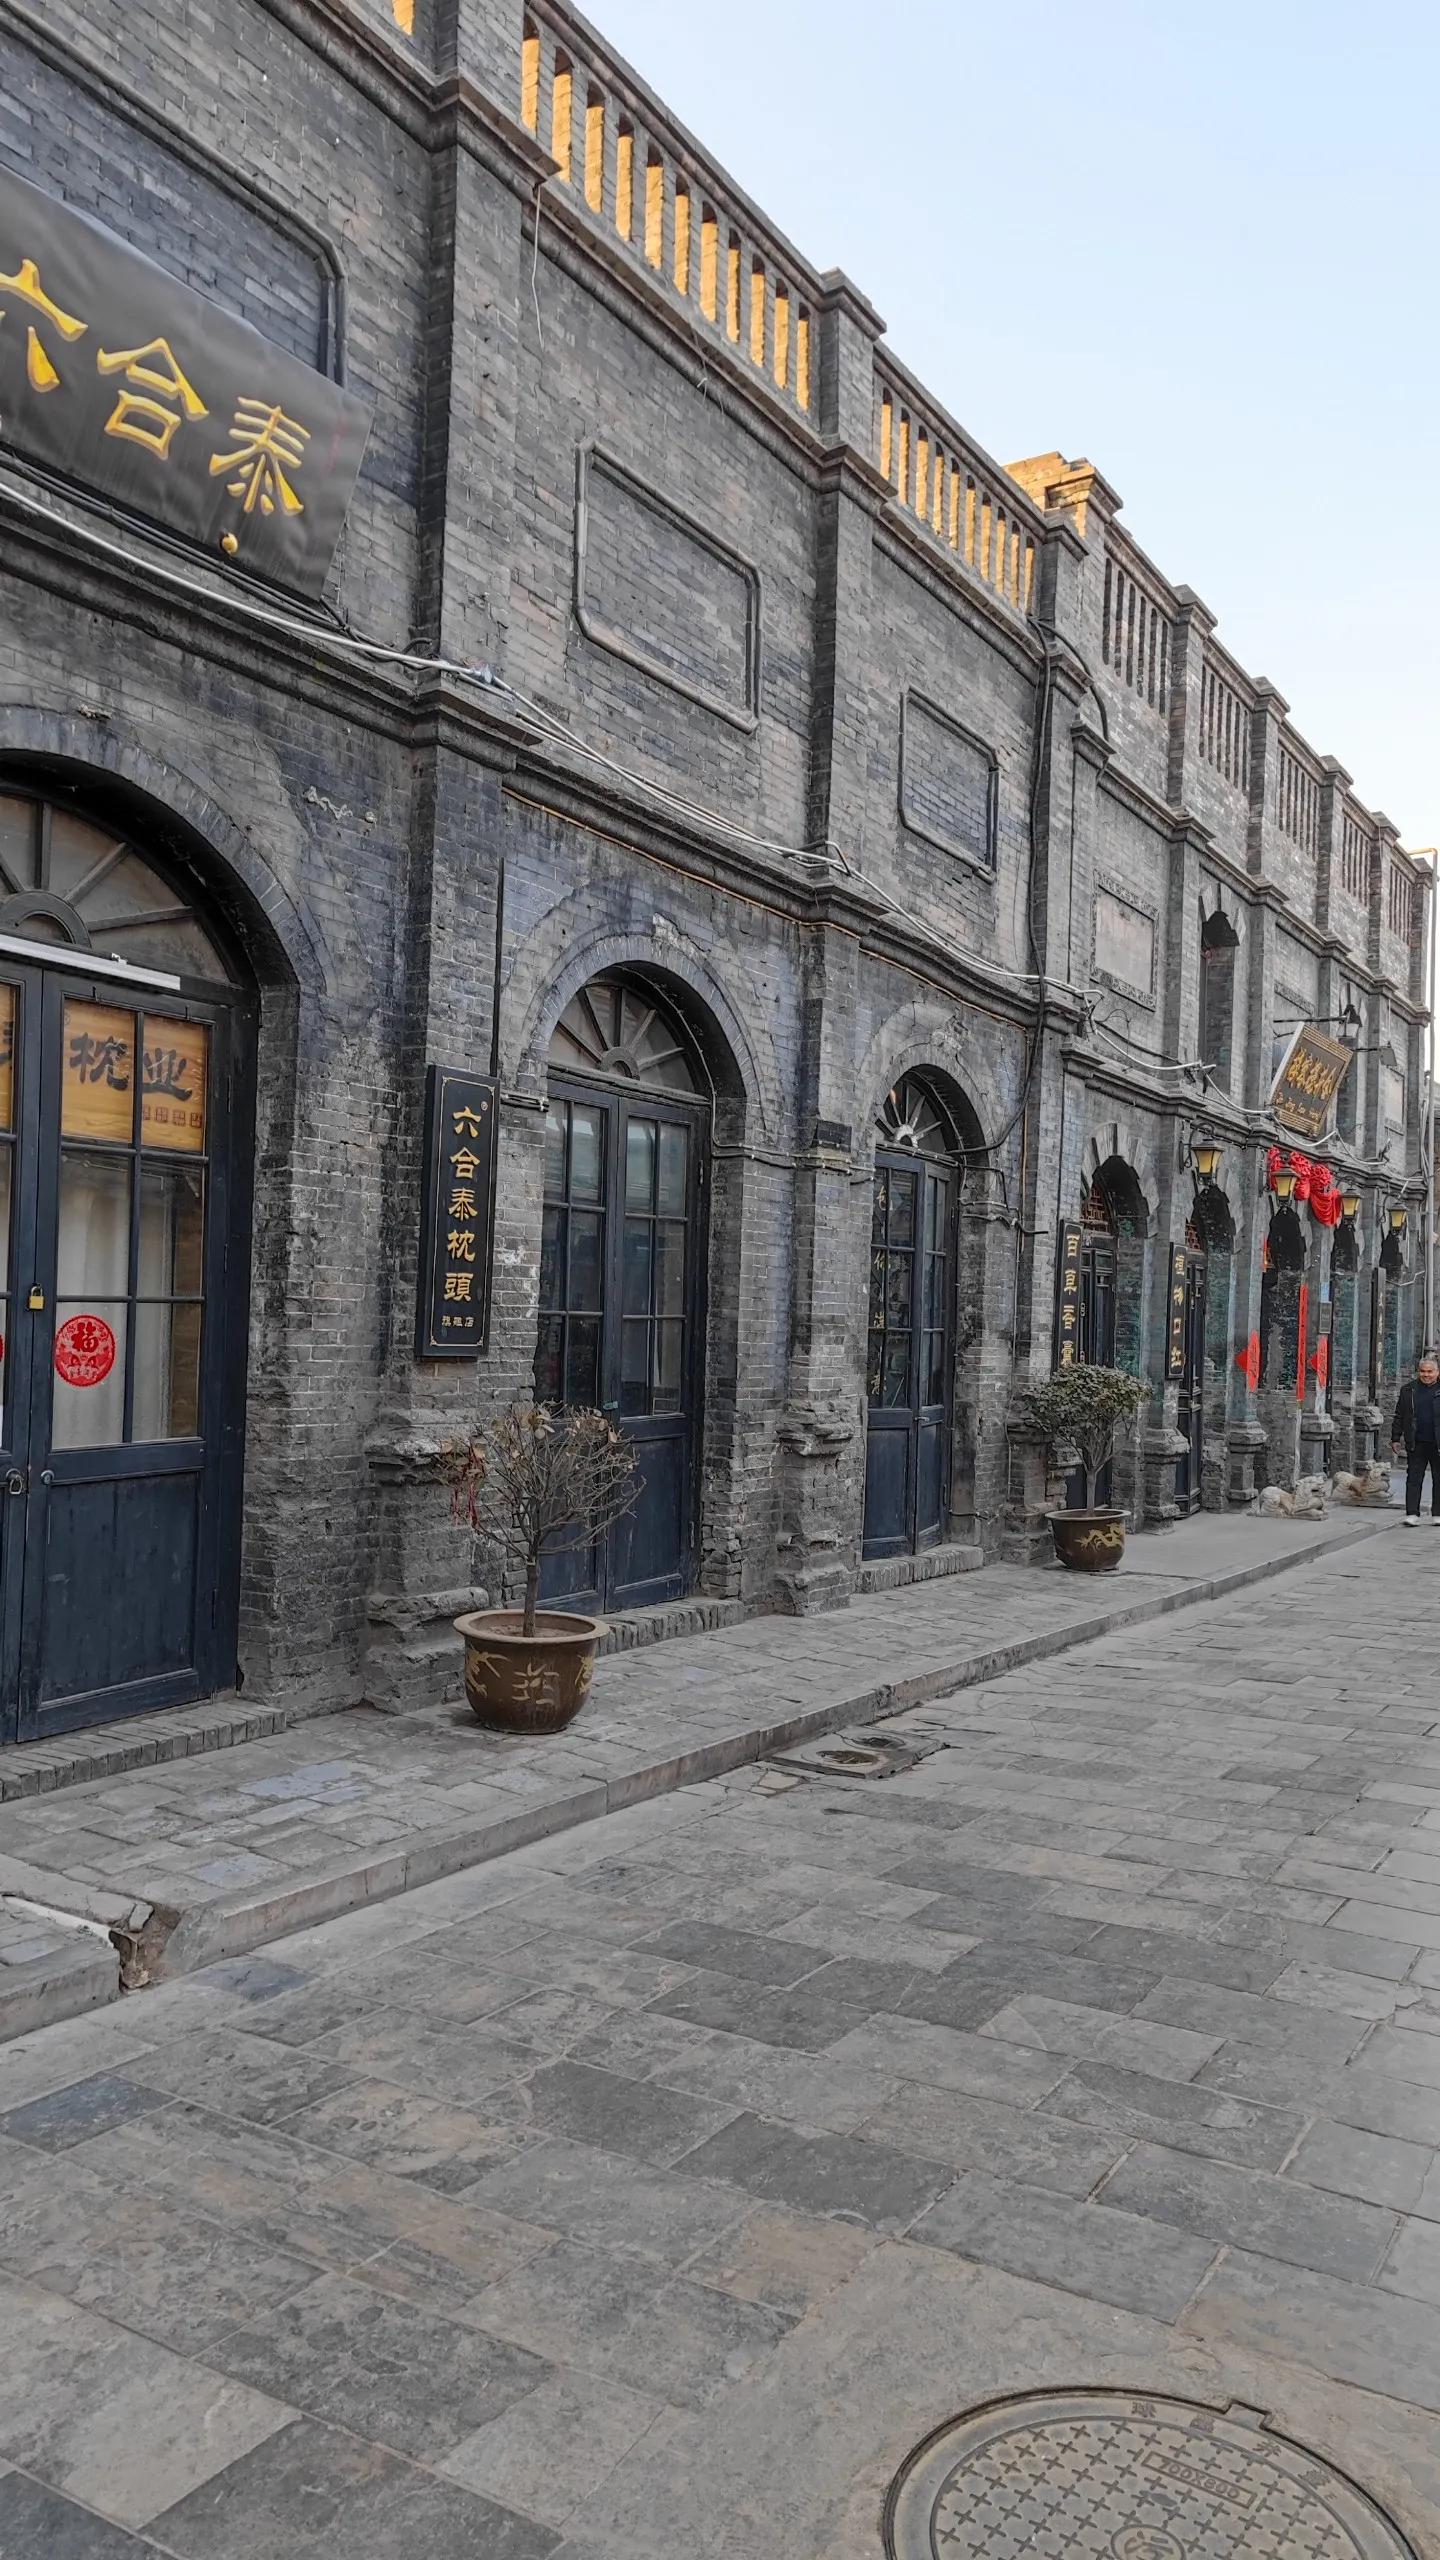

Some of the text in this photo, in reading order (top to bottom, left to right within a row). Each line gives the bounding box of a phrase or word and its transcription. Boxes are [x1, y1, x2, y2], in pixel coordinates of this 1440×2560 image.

[0, 258, 311, 517] 六合泰
[443, 1105, 482, 1302] 六合泰枕頭
[71, 1321, 100, 1353] 福
